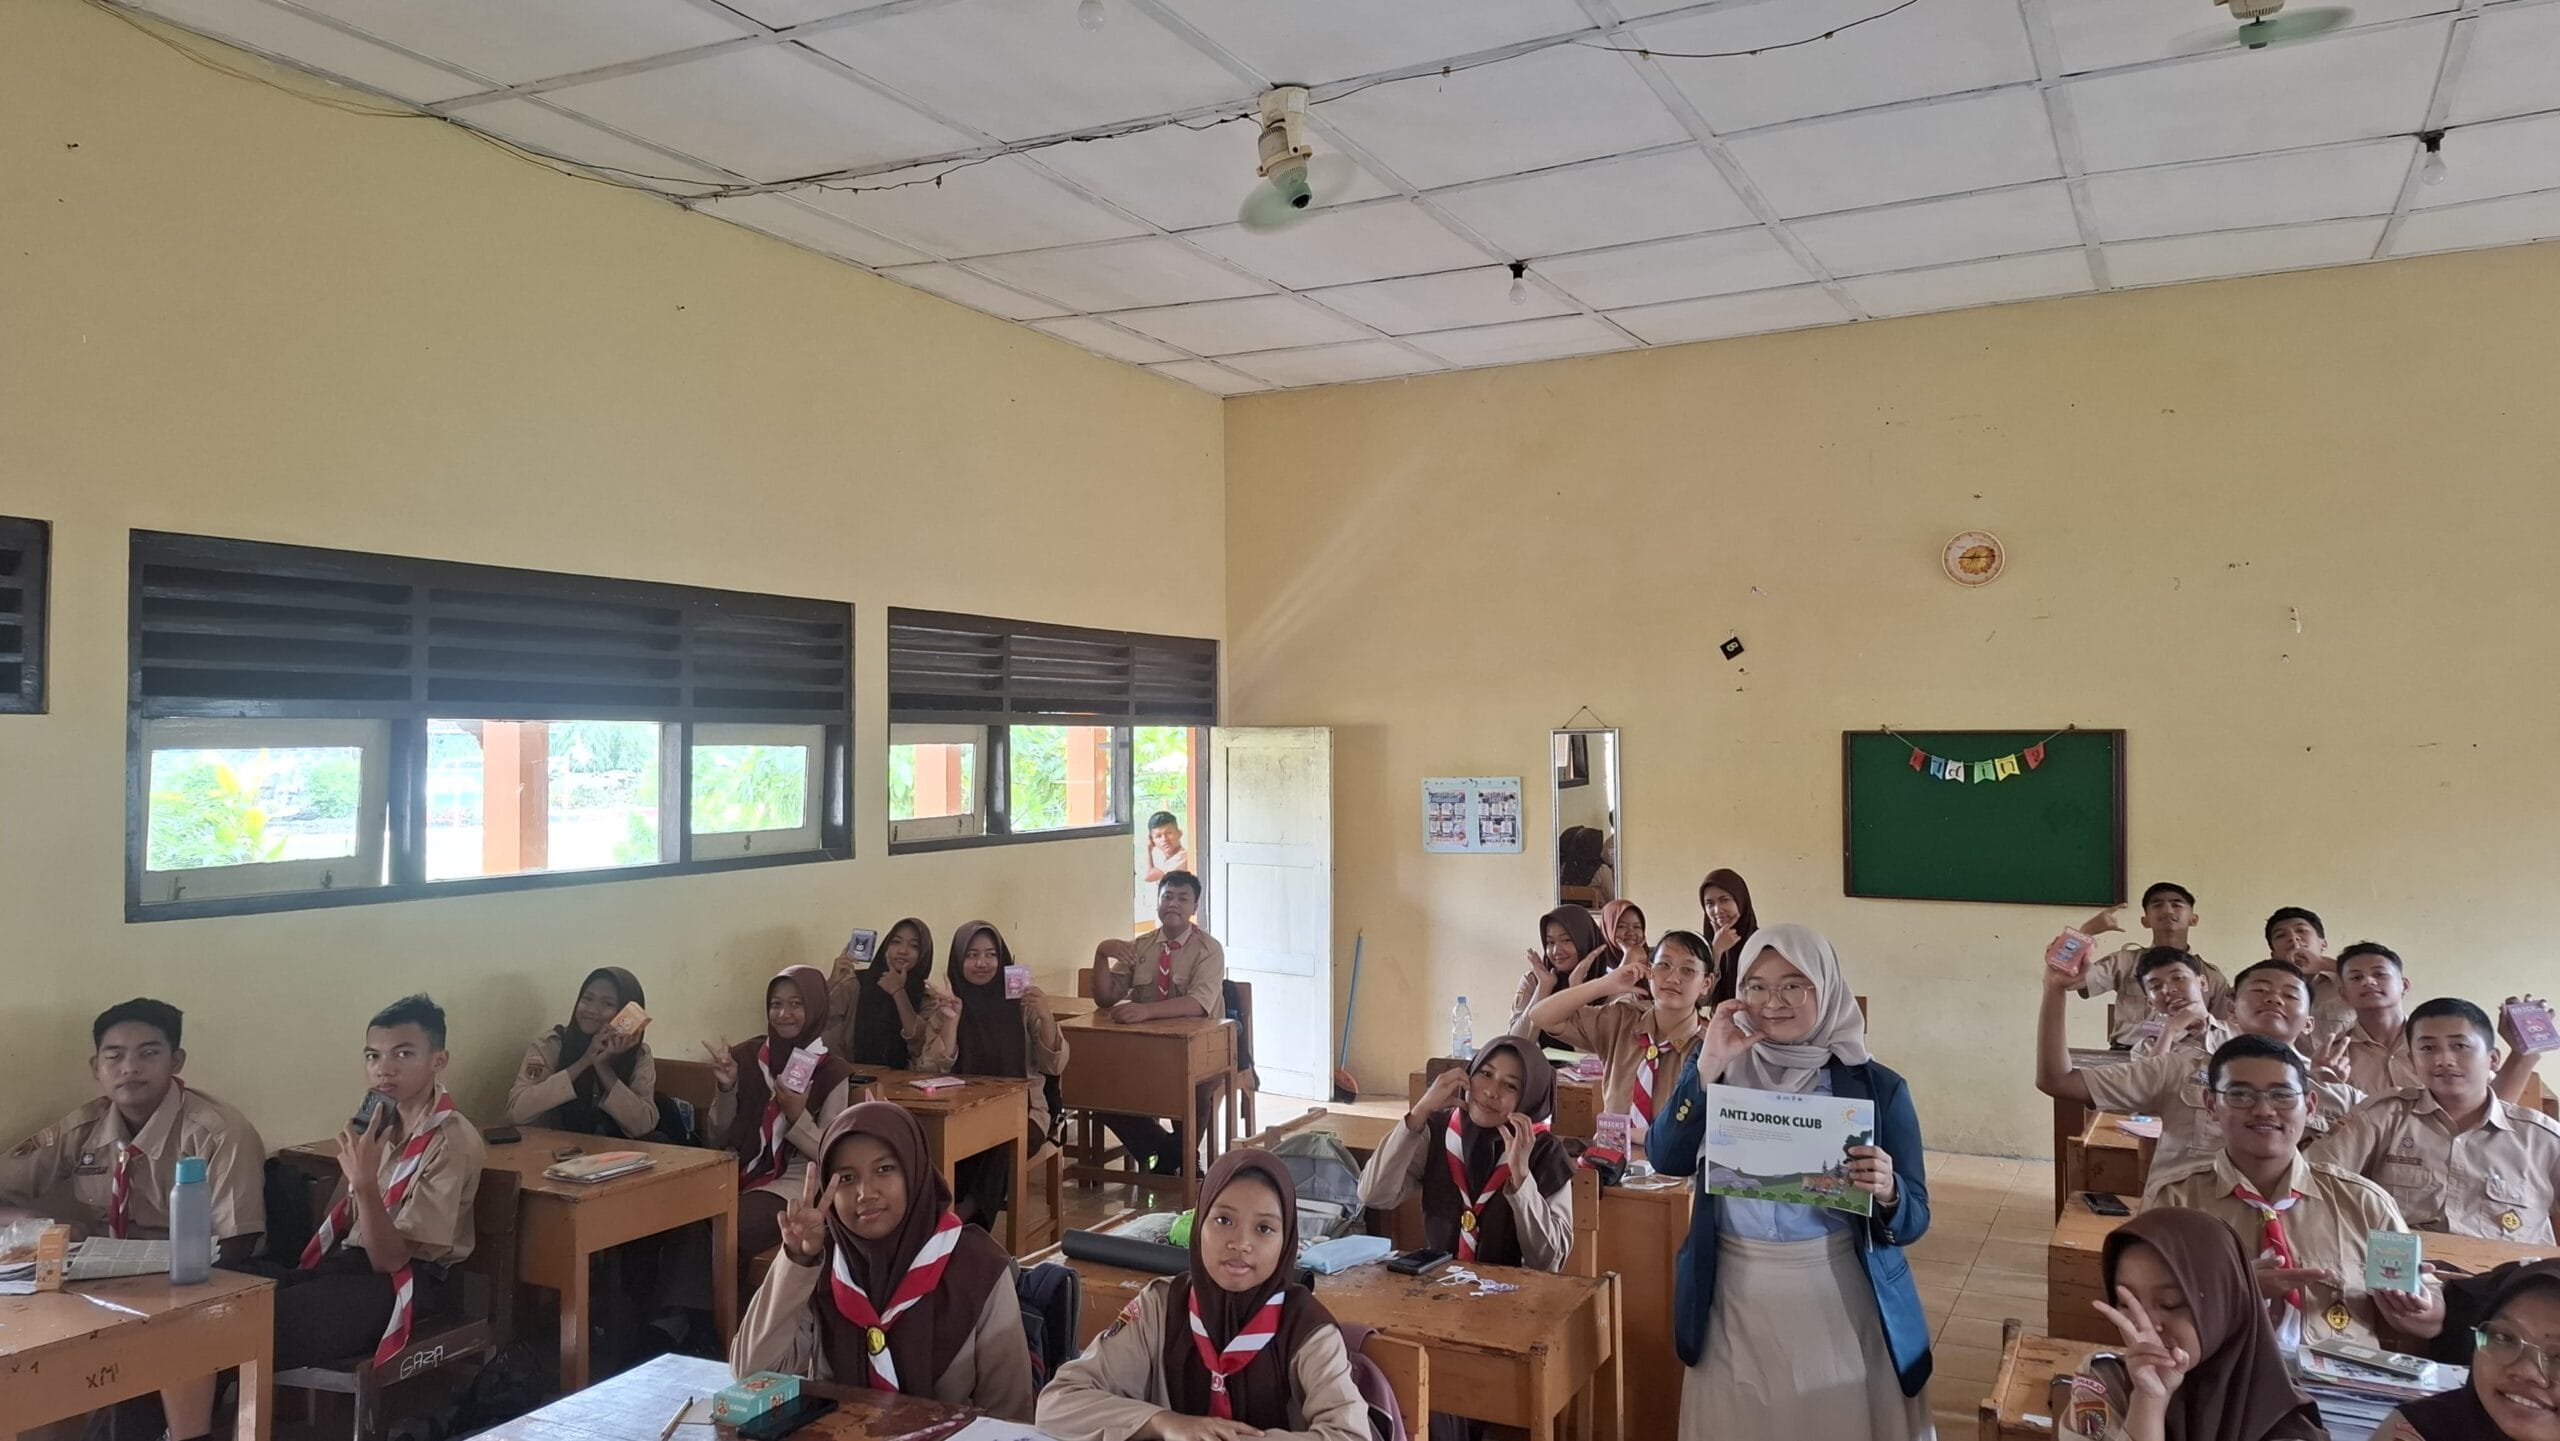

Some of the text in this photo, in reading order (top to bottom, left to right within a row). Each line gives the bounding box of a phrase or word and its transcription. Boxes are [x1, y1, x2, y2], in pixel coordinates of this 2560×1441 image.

[1720, 1107, 1822, 1129] ANTI JOROK CLUB
[2369, 1230, 2417, 1243] BRICKS
[400, 1345, 443, 1379] GAZA
